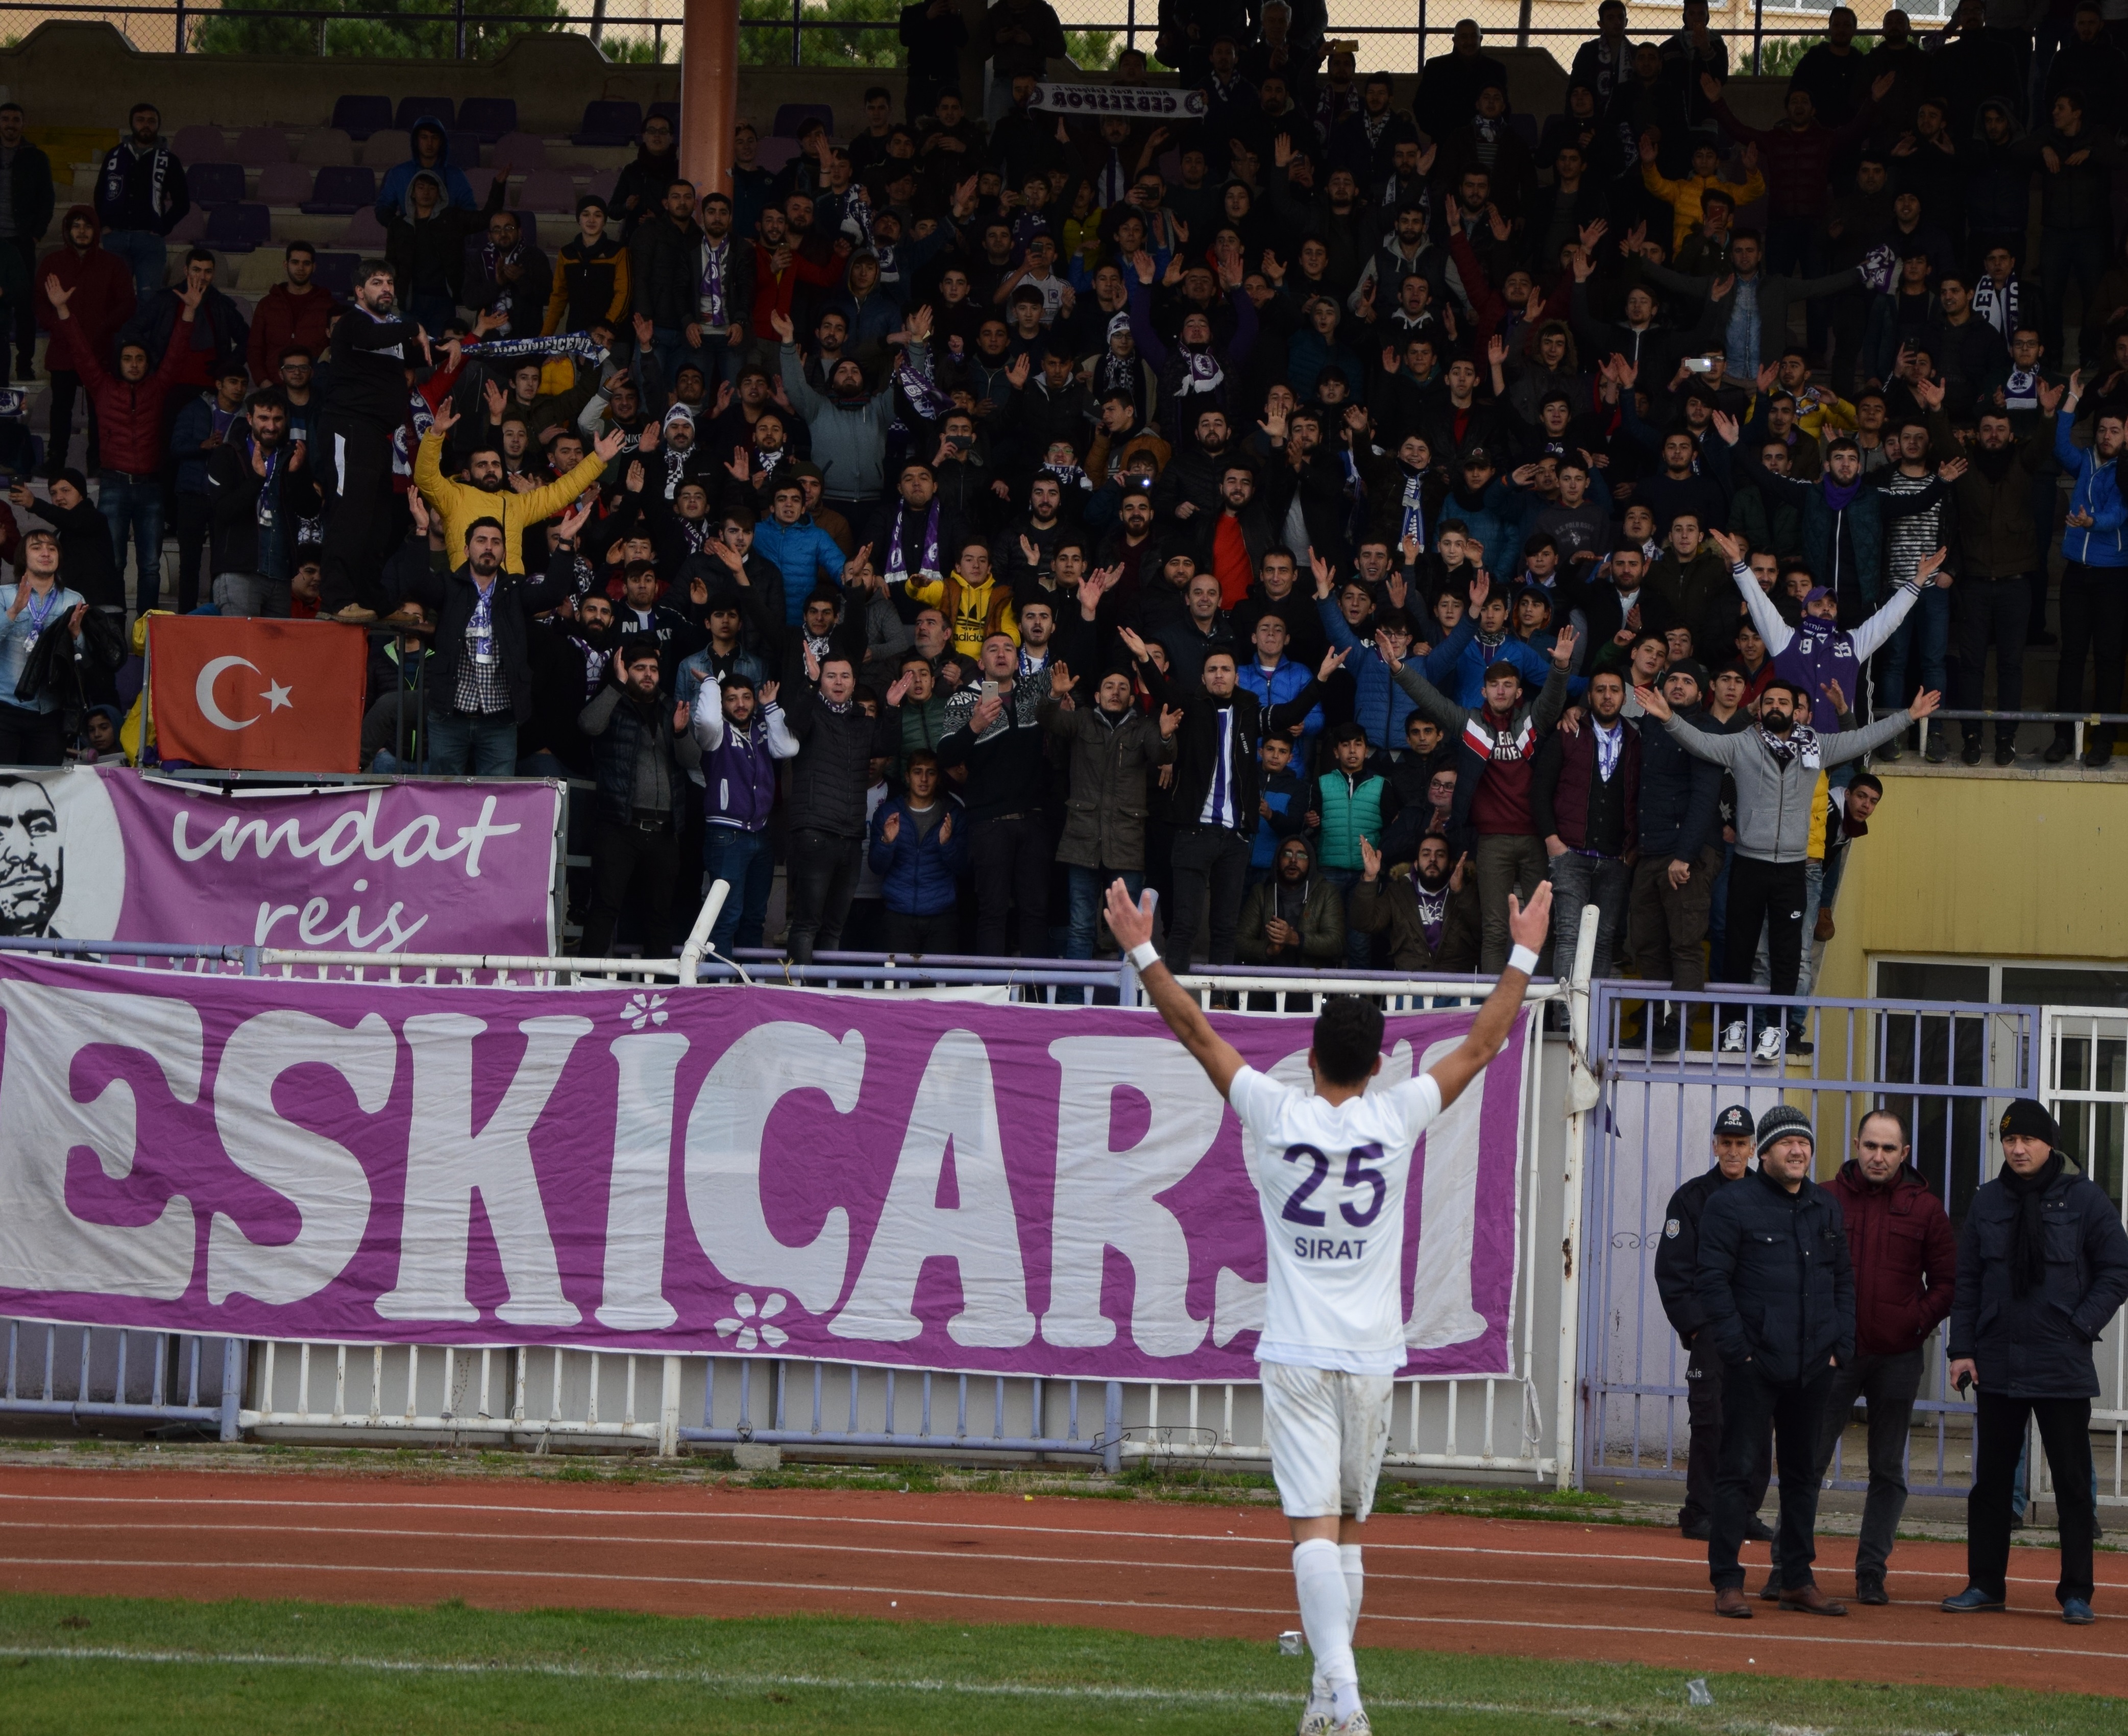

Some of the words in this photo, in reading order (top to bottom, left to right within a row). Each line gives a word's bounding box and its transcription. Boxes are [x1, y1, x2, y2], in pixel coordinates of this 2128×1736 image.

[254, 878, 429, 953] reis
[1282, 1143, 1387, 1228] 25
[1294, 1236, 1367, 1260] SIRAT
